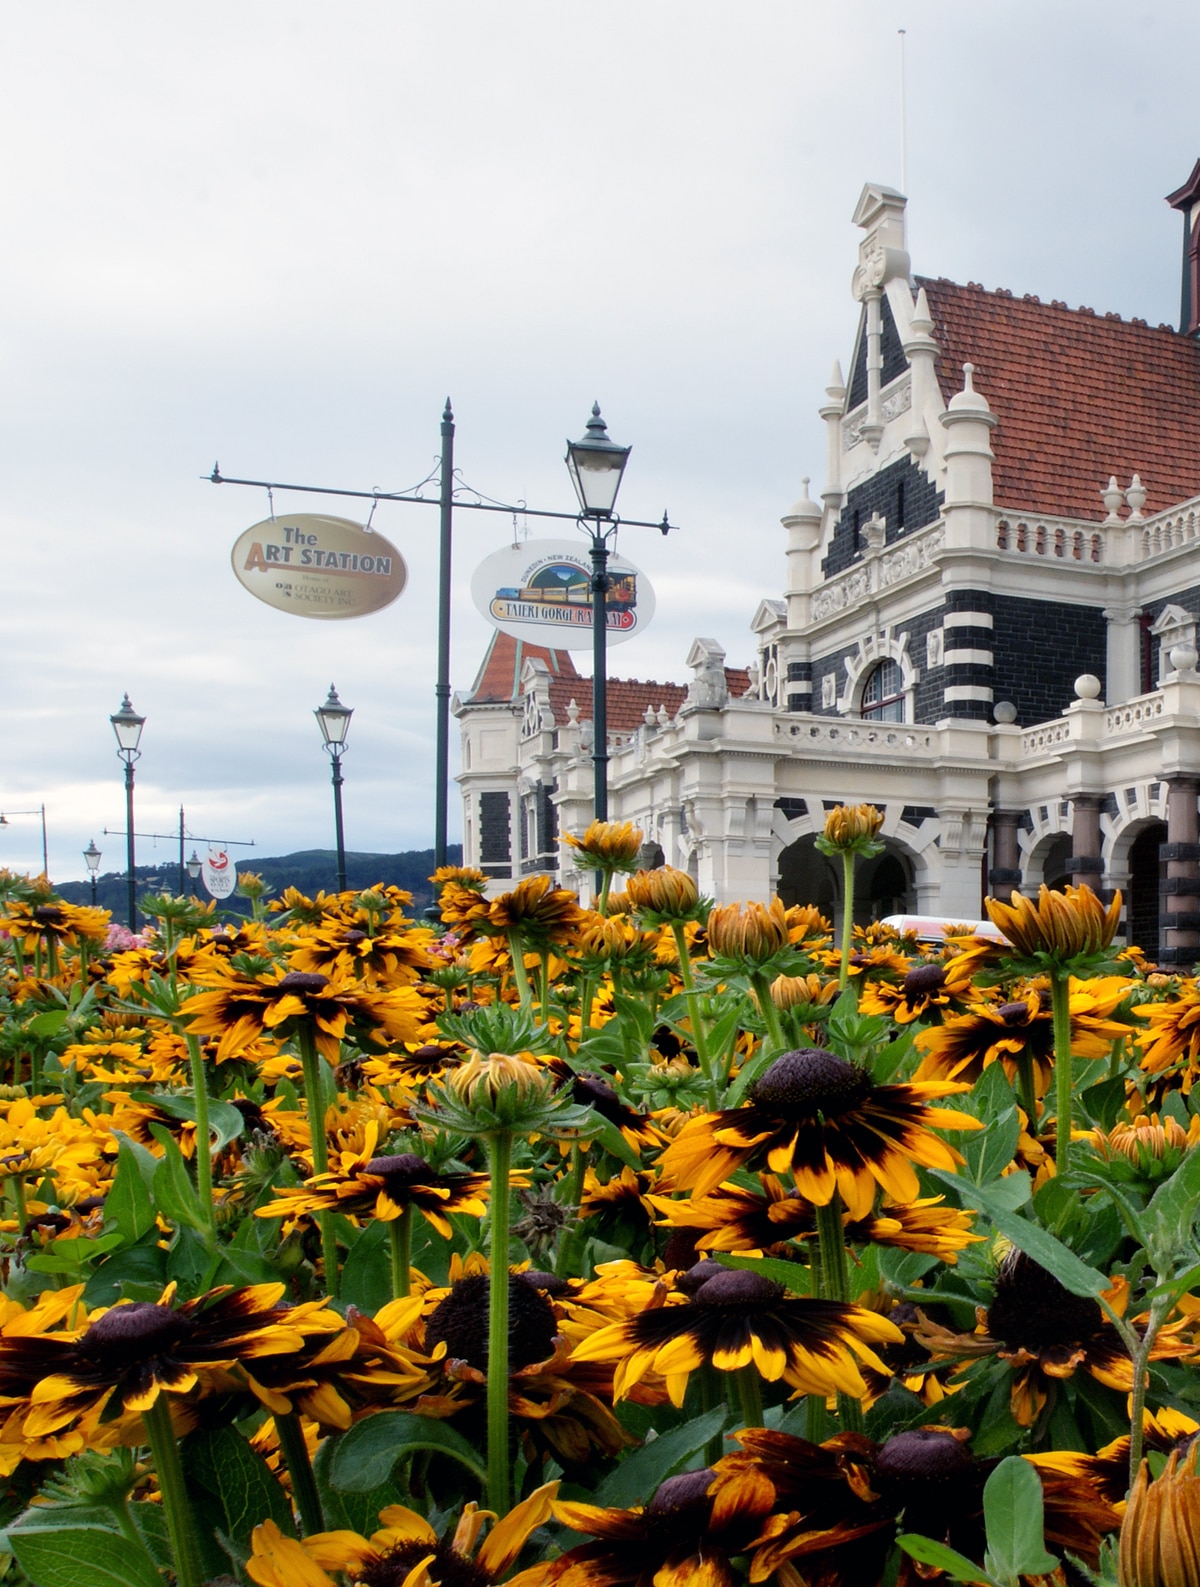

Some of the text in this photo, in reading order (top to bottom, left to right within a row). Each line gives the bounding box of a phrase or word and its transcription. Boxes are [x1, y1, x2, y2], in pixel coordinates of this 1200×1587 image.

[283, 527, 318, 546] The
[244, 542, 392, 575] ART STATION
[521, 559, 544, 583] DUNEDIN
[294, 584, 354, 597] OTAGO ART
[294, 592, 335, 604] SOCIETY
[506, 603, 539, 618] TAIERI
[541, 607, 575, 621] GORGE
